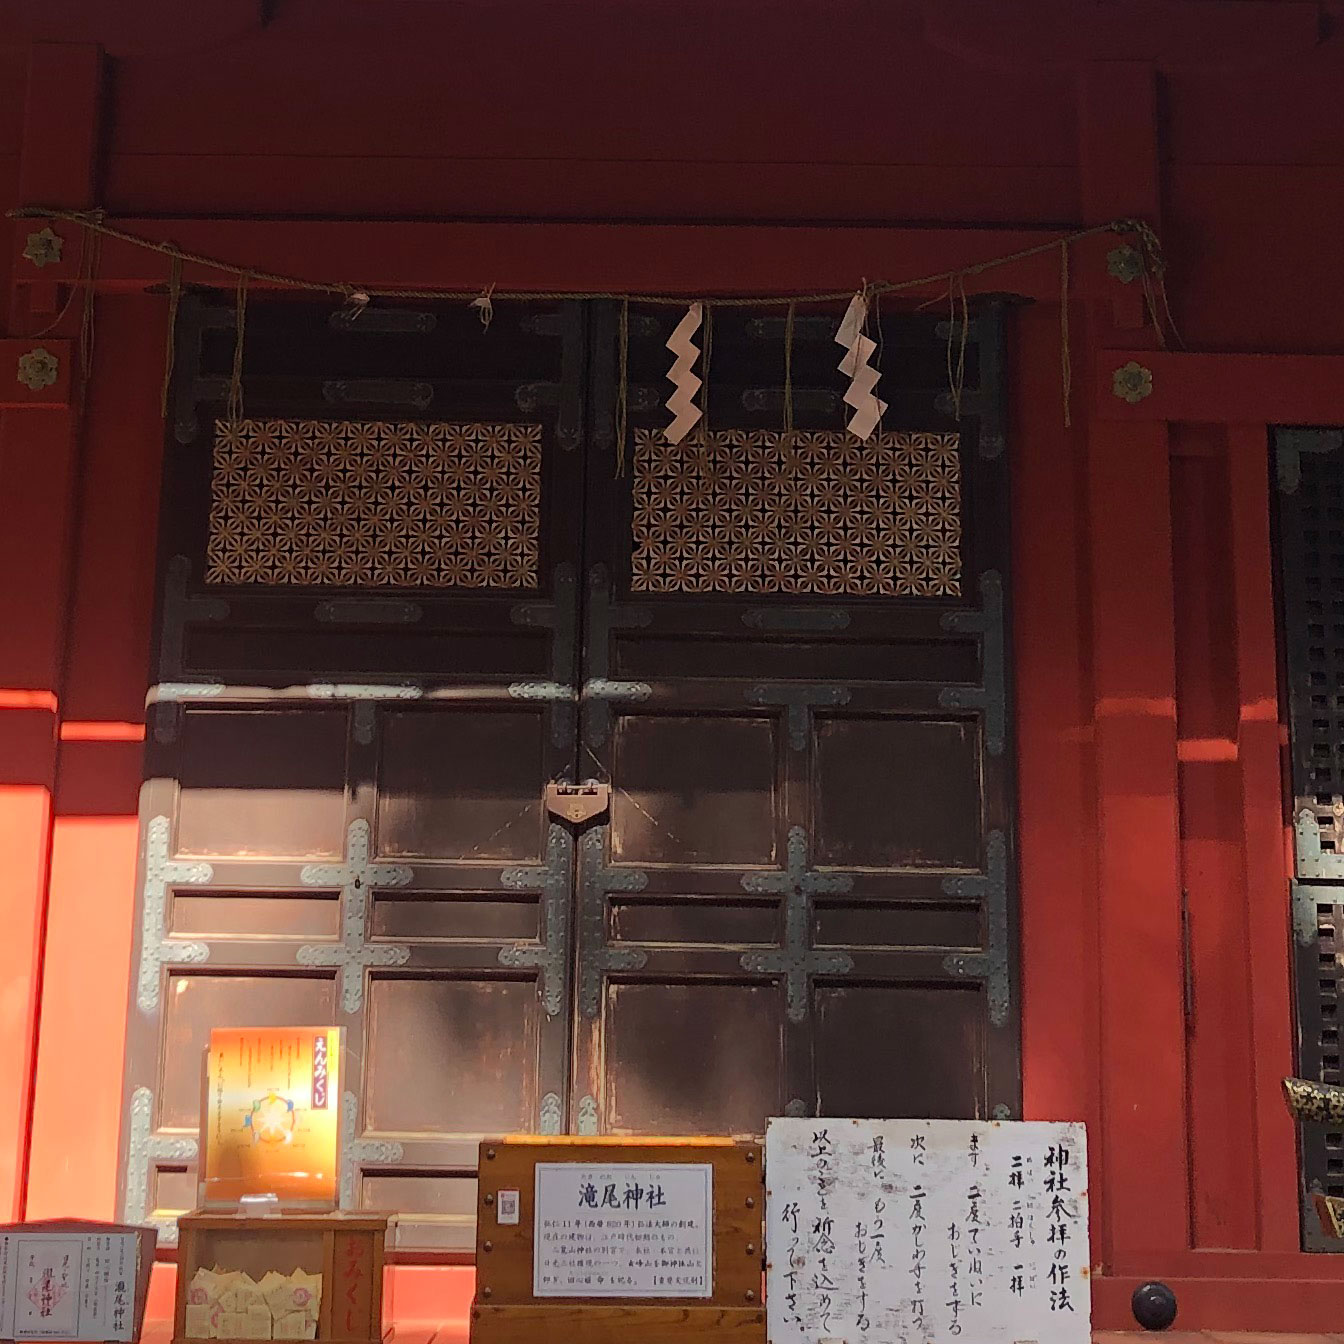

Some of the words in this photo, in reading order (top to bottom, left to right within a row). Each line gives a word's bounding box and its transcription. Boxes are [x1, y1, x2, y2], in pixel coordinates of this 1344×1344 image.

[314, 1037, 327, 1106] えんみくじ
[910, 1134, 926, 1166] 次に
[1008, 1155, 1024, 1190] 二拝
[578, 1182, 667, 1210] 滝尾神社
[1007, 1200, 1024, 1248] 二拍手
[1043, 1144, 1074, 1312] 神社参拝の作法
[1009, 1264, 1025, 1297] 一拝
